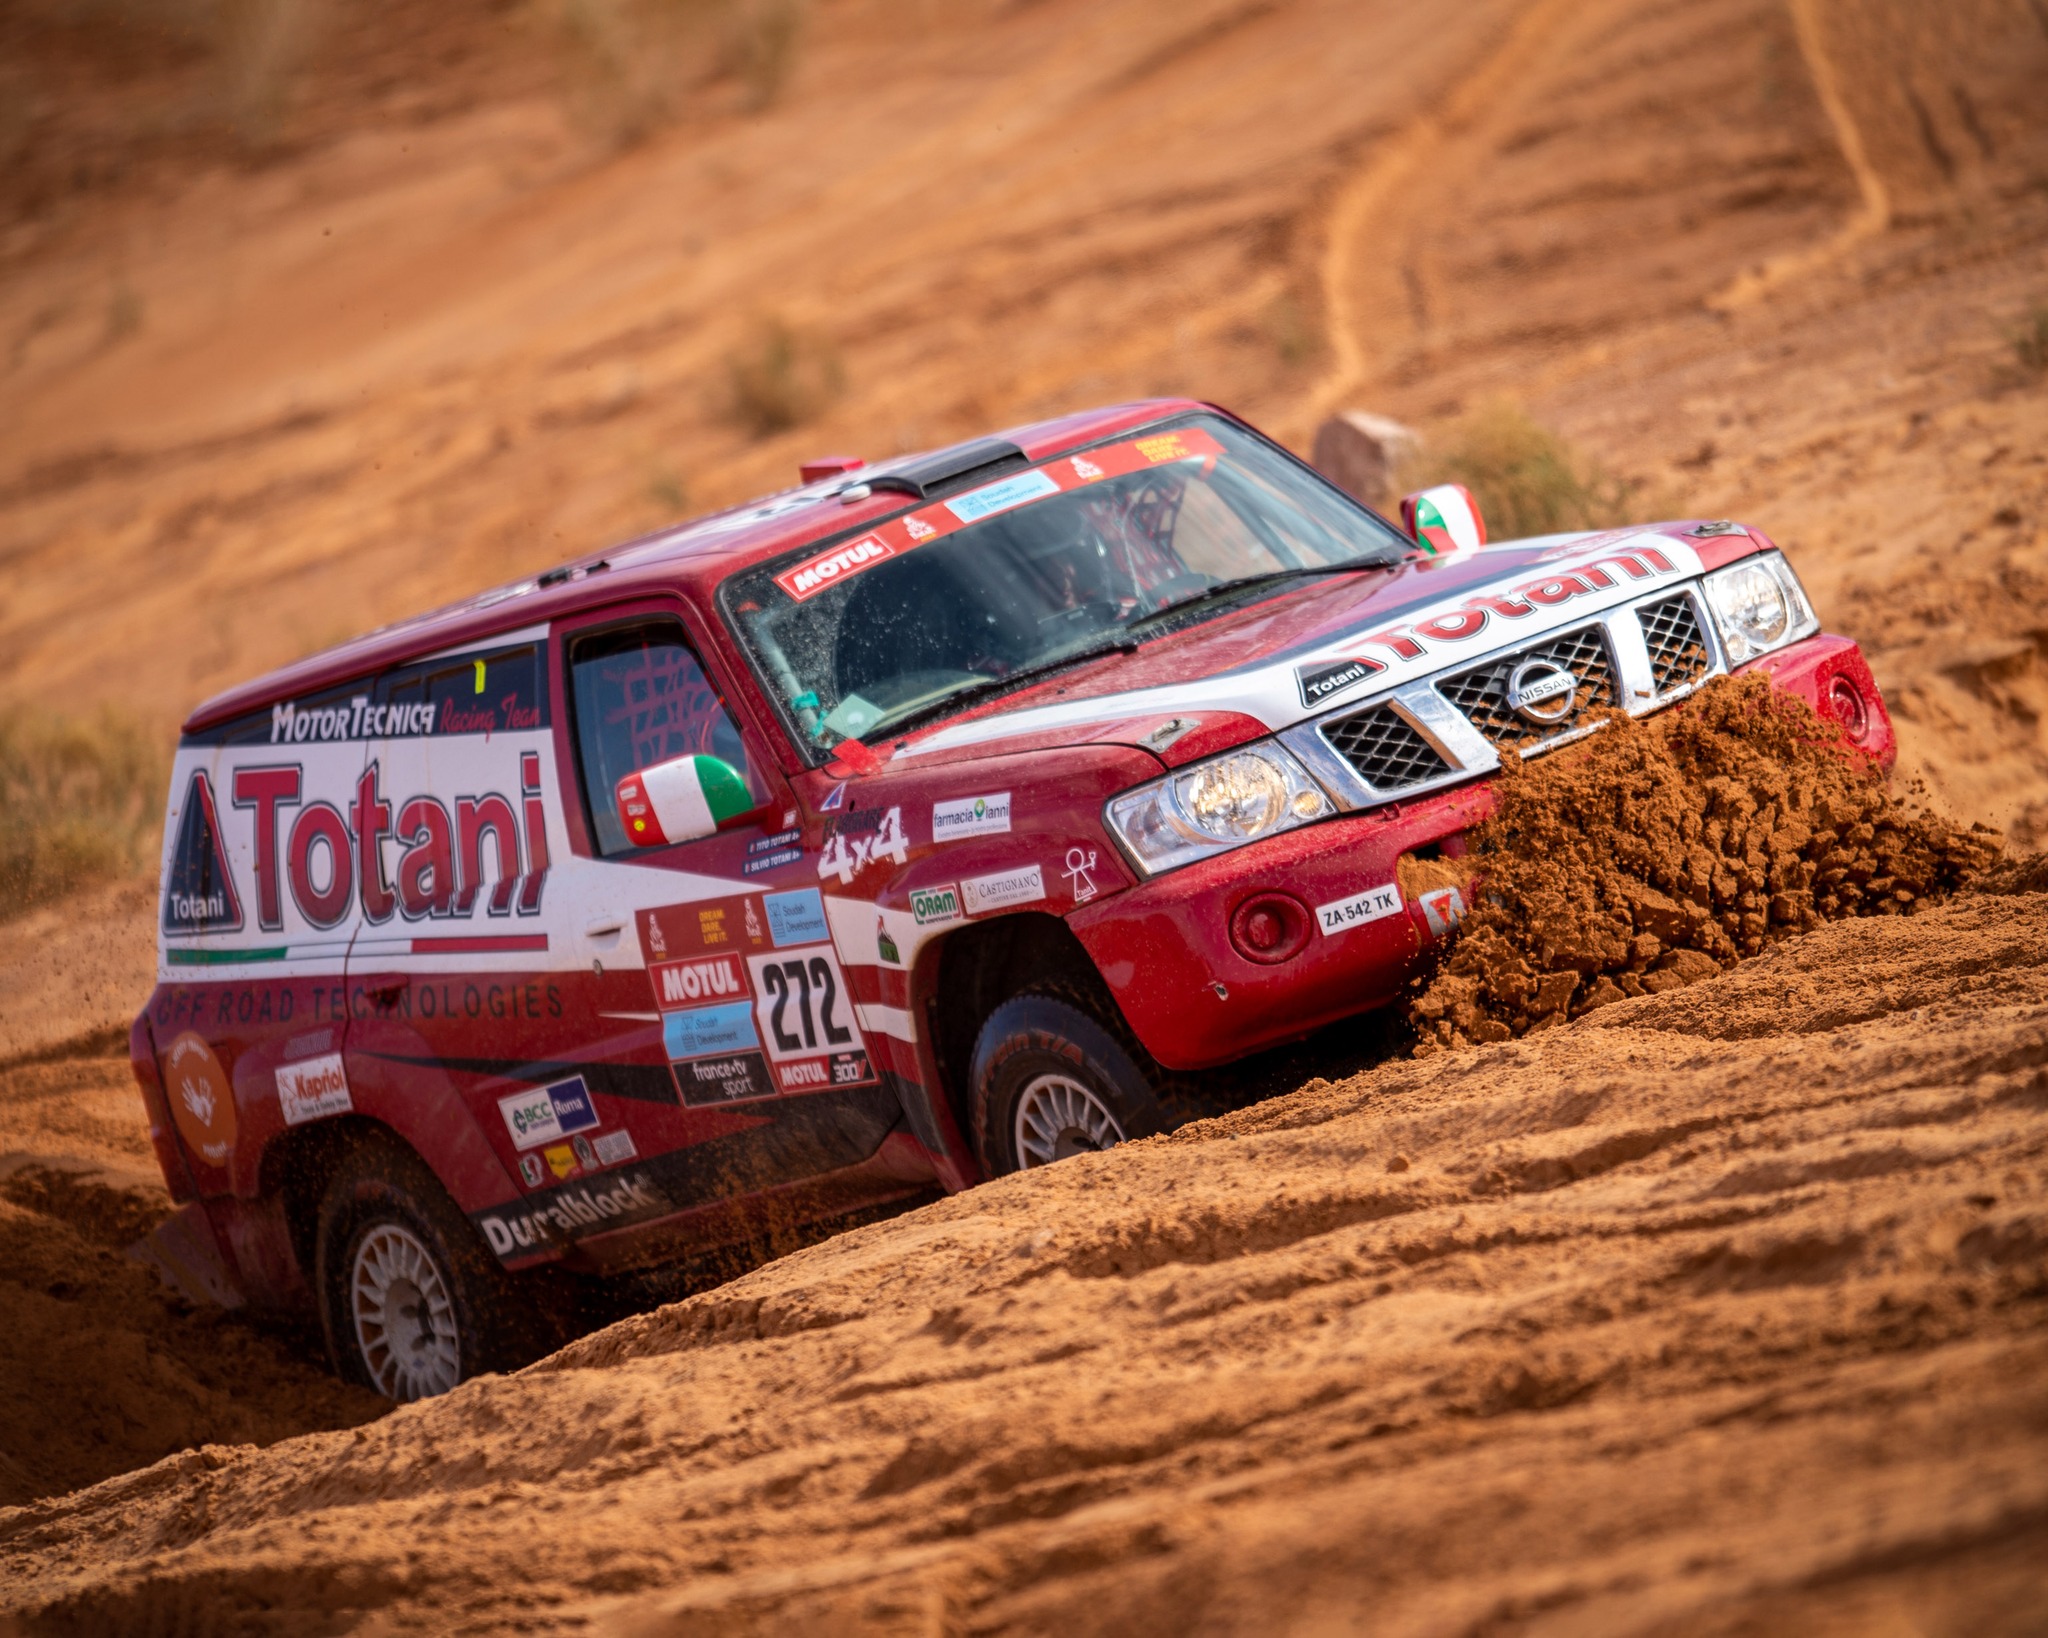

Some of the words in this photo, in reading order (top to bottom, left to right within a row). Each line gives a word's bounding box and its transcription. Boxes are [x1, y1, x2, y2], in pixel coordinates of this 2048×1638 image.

[792, 539, 885, 593] MOTUL
[1336, 547, 1681, 662] Totani
[1307, 664, 1366, 697] Totani
[1517, 678, 1572, 702] NISSAN
[934, 808, 973, 828] farmacia
[232, 751, 551, 931] Totani
[756, 839, 770, 852] TITO
[770, 833, 792, 848] TOTANI
[751, 858, 770, 872] SILVIO
[770, 852, 792, 866] TOTANI
[979, 872, 1039, 898] CASTIGNANO
[1076, 885, 1093, 897] Tanit
[171, 890, 224, 920] Totani
[916, 892, 957, 918] ORAM
[1374, 892, 1394, 910] TK
[785, 917, 824, 934] Development
[661, 960, 739, 1002] MOTUL
[155, 990, 207, 1027] OFF
[218, 987, 295, 1025] ROAD
[762, 956, 852, 1052] 272
[294, 1064, 345, 1101] Kapriol
[780, 1062, 827, 1087] MOTUL
[833, 1059, 867, 1084] 300V
[722, 1077, 753, 1100] sport
[523, 1102, 552, 1123] BCC
[553, 1097, 584, 1117] Roma
[481, 1177, 655, 1256] Duralblock
